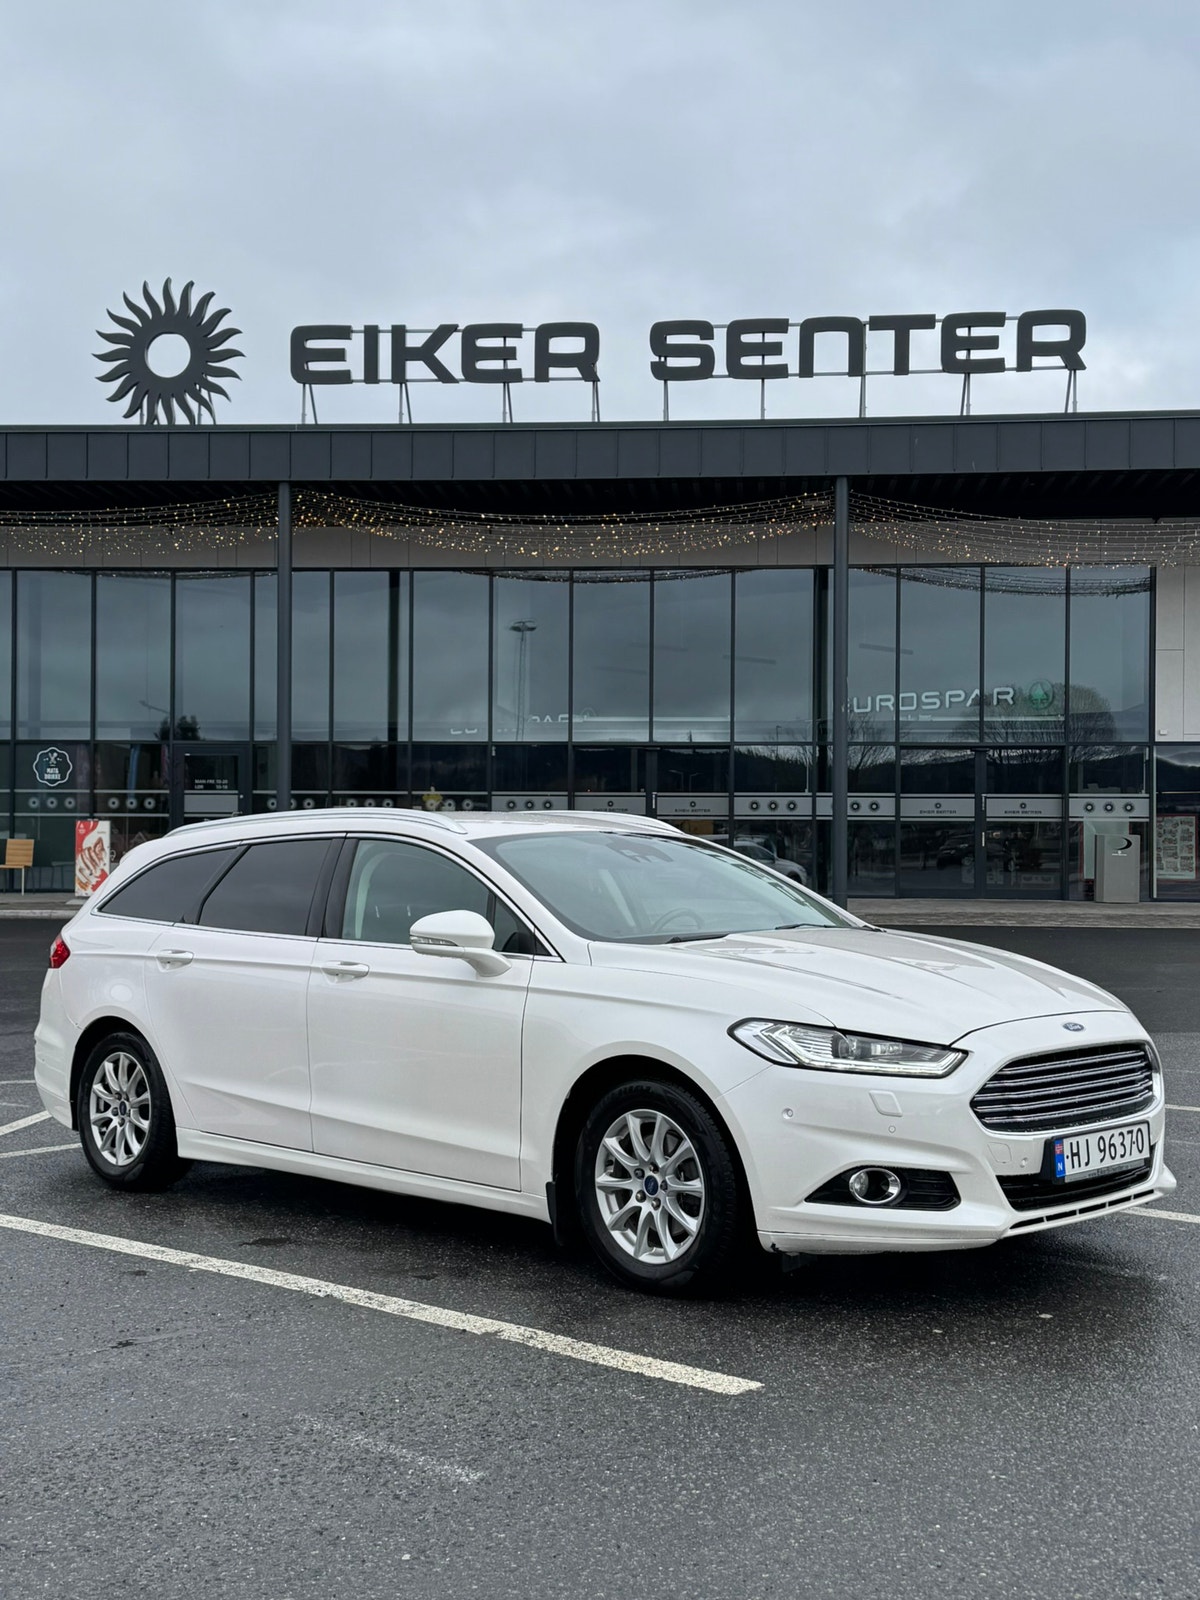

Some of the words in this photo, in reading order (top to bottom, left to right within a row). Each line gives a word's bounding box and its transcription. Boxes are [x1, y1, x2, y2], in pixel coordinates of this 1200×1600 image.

[290, 321, 601, 384] EIKER
[650, 309, 1087, 381] SENTER
[847, 686, 1015, 713] UROSPAR
[1069, 1140, 1091, 1170] HJ
[1097, 1127, 1145, 1164] 96370
[1057, 1161, 1064, 1172] N
